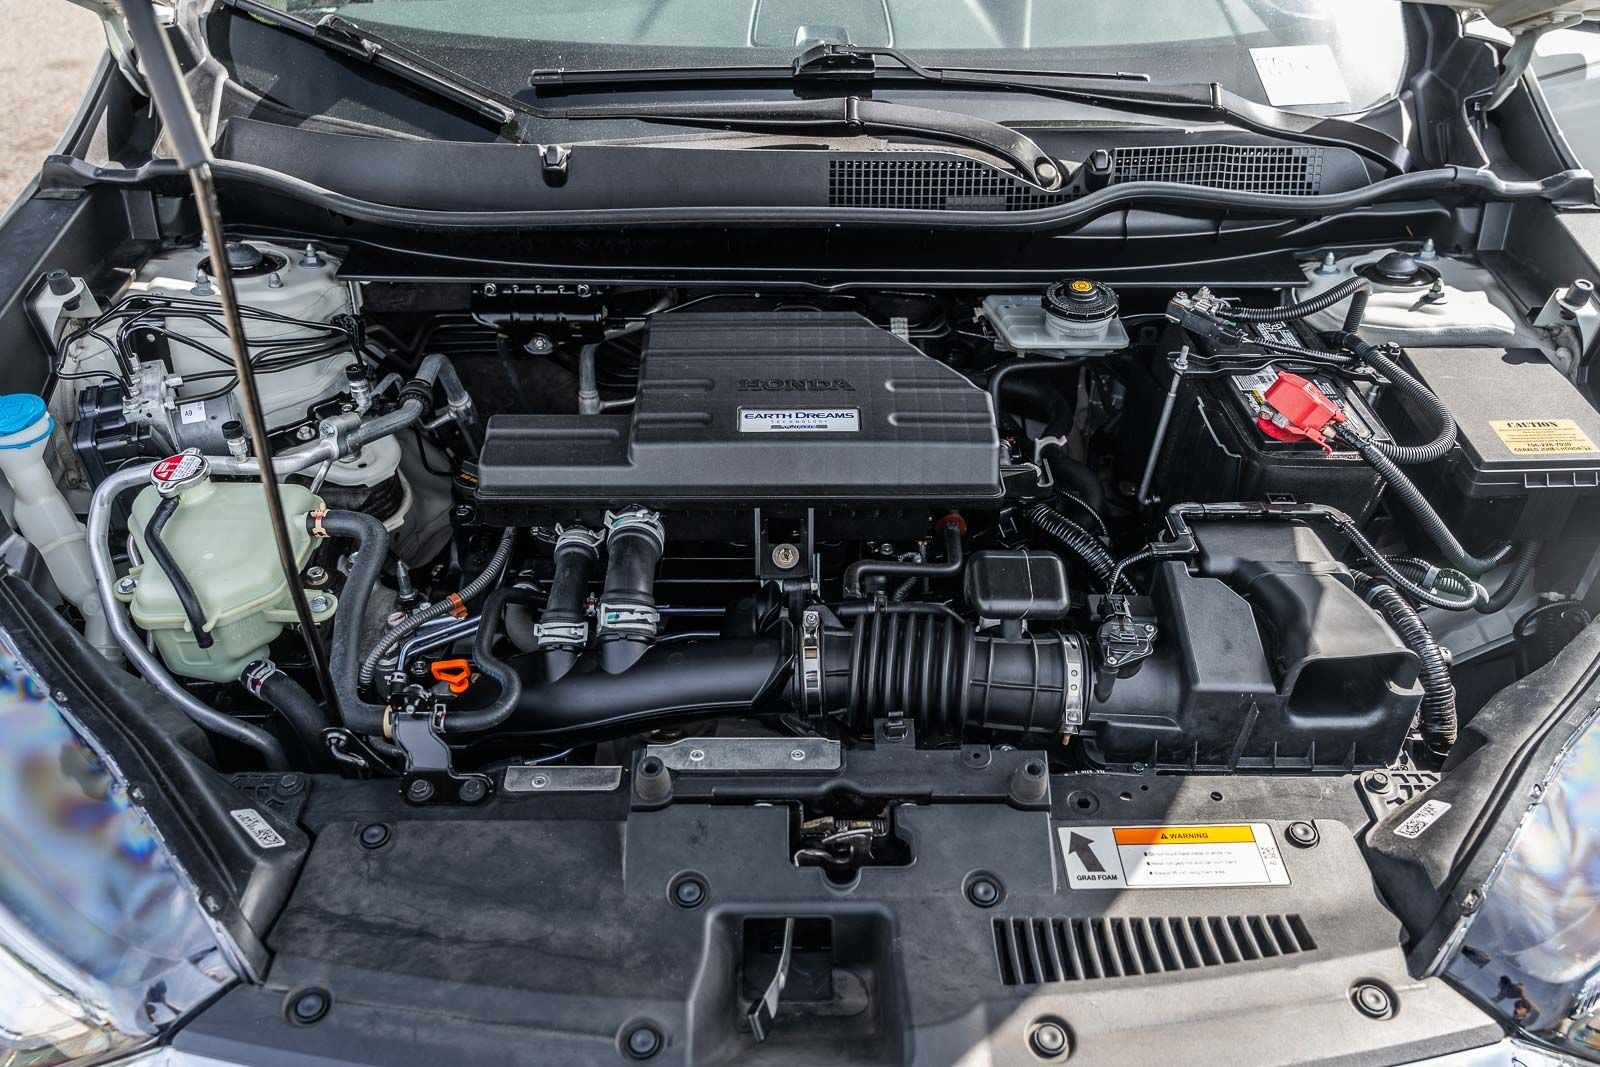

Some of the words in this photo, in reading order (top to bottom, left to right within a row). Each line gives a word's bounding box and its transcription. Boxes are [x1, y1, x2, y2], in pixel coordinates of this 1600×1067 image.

[738, 378, 856, 391] HONDA
[795, 411, 854, 419] DREAMS
[1169, 831, 1209, 840] WARNING
[1098, 873, 1118, 881] FOAM
